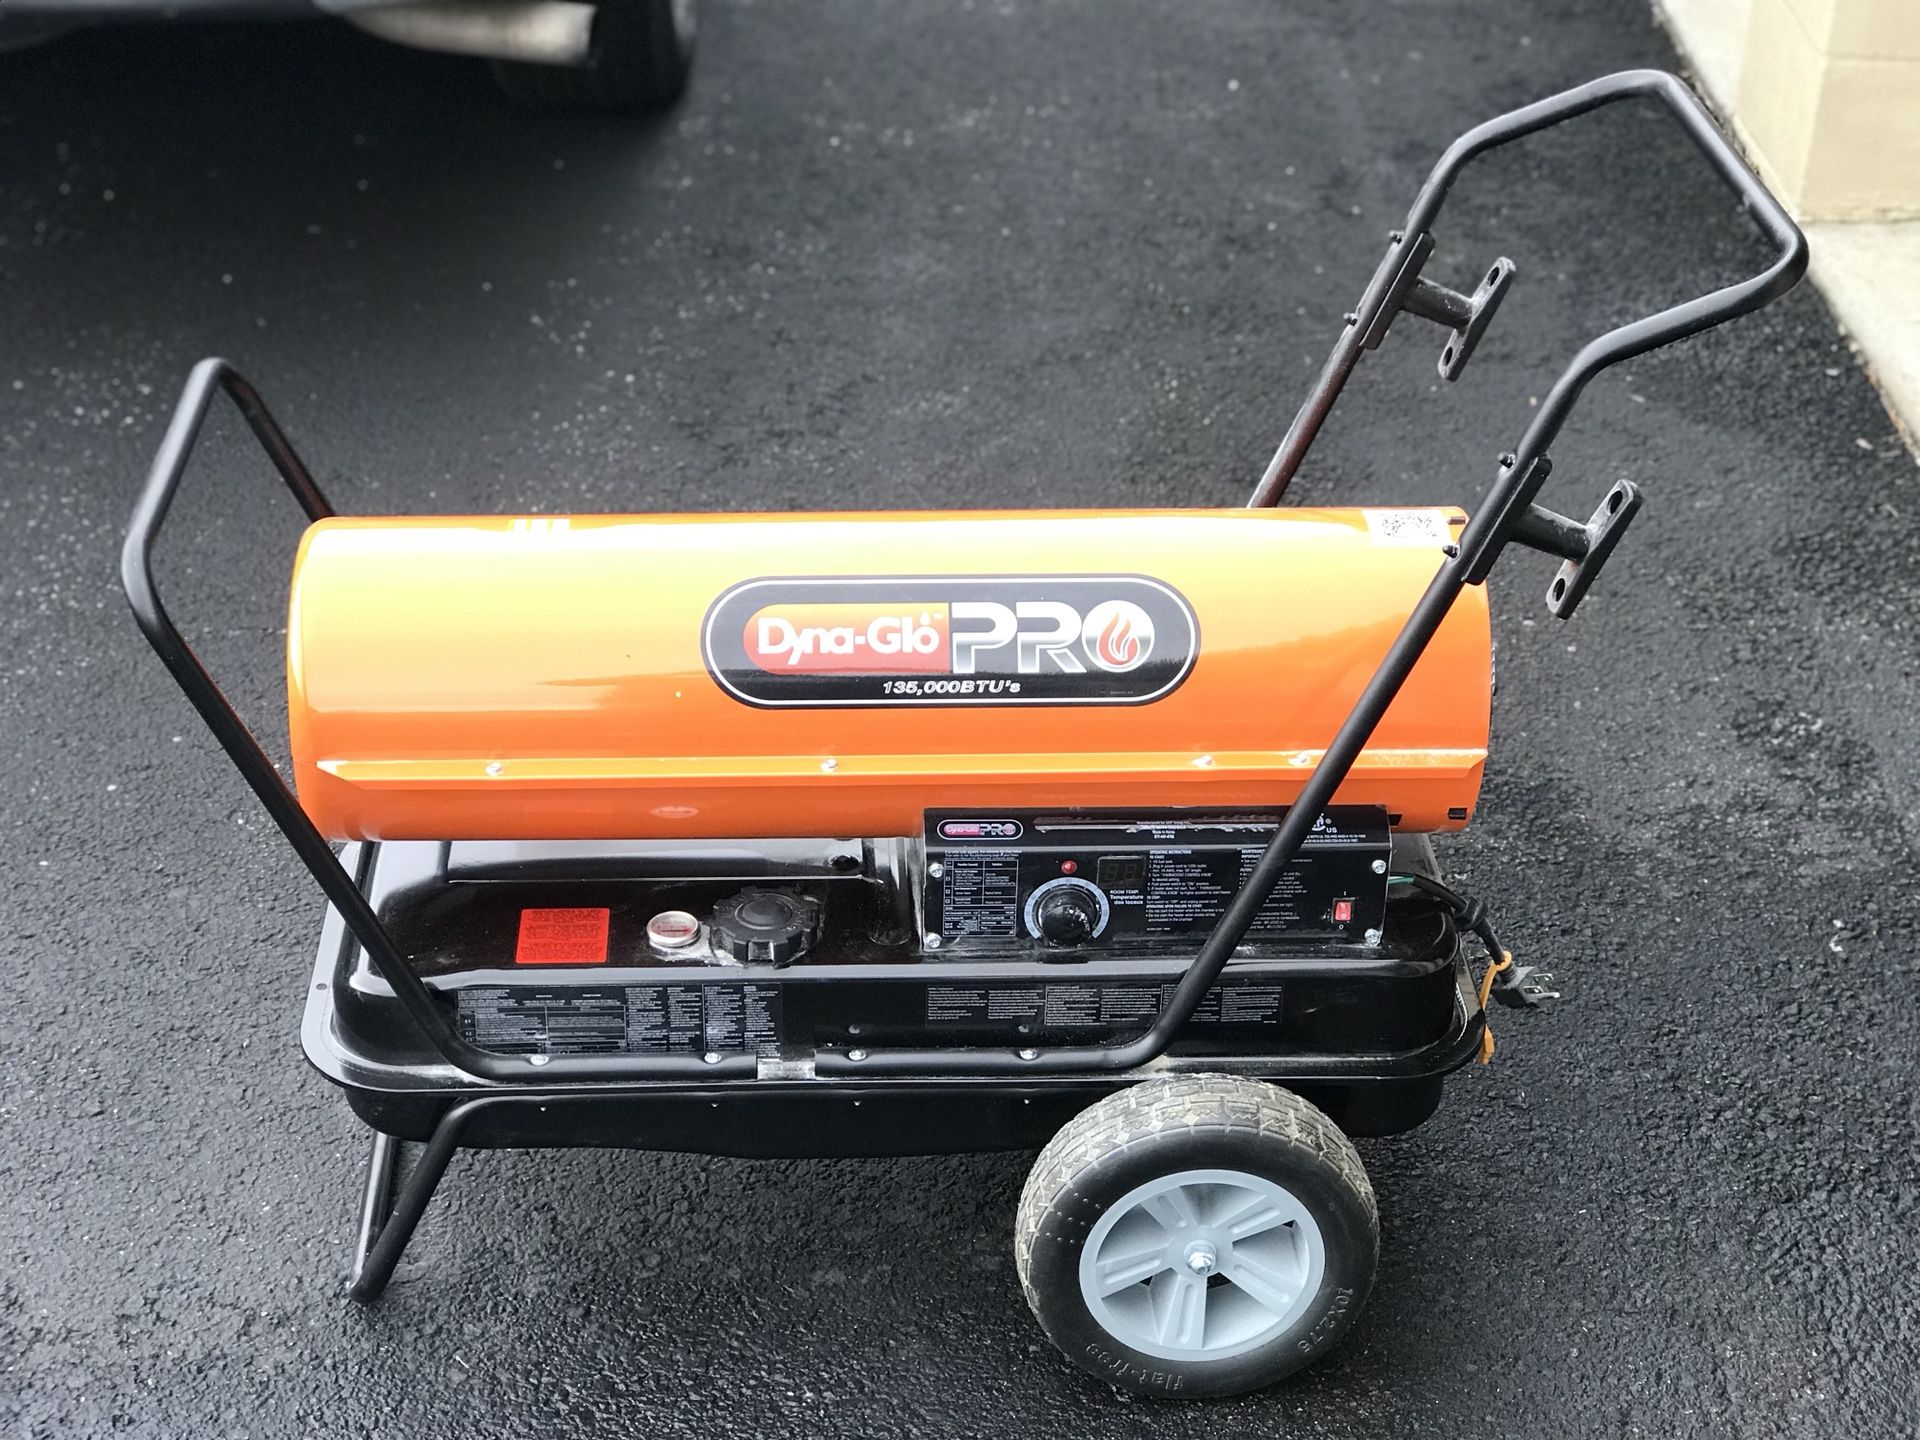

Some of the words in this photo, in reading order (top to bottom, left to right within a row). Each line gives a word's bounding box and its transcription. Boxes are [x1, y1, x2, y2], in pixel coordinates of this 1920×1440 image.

[951, 600, 1155, 674] PRO
[883, 680, 1021, 696] 135,000BTU's
[980, 823, 1016, 836] PRO
